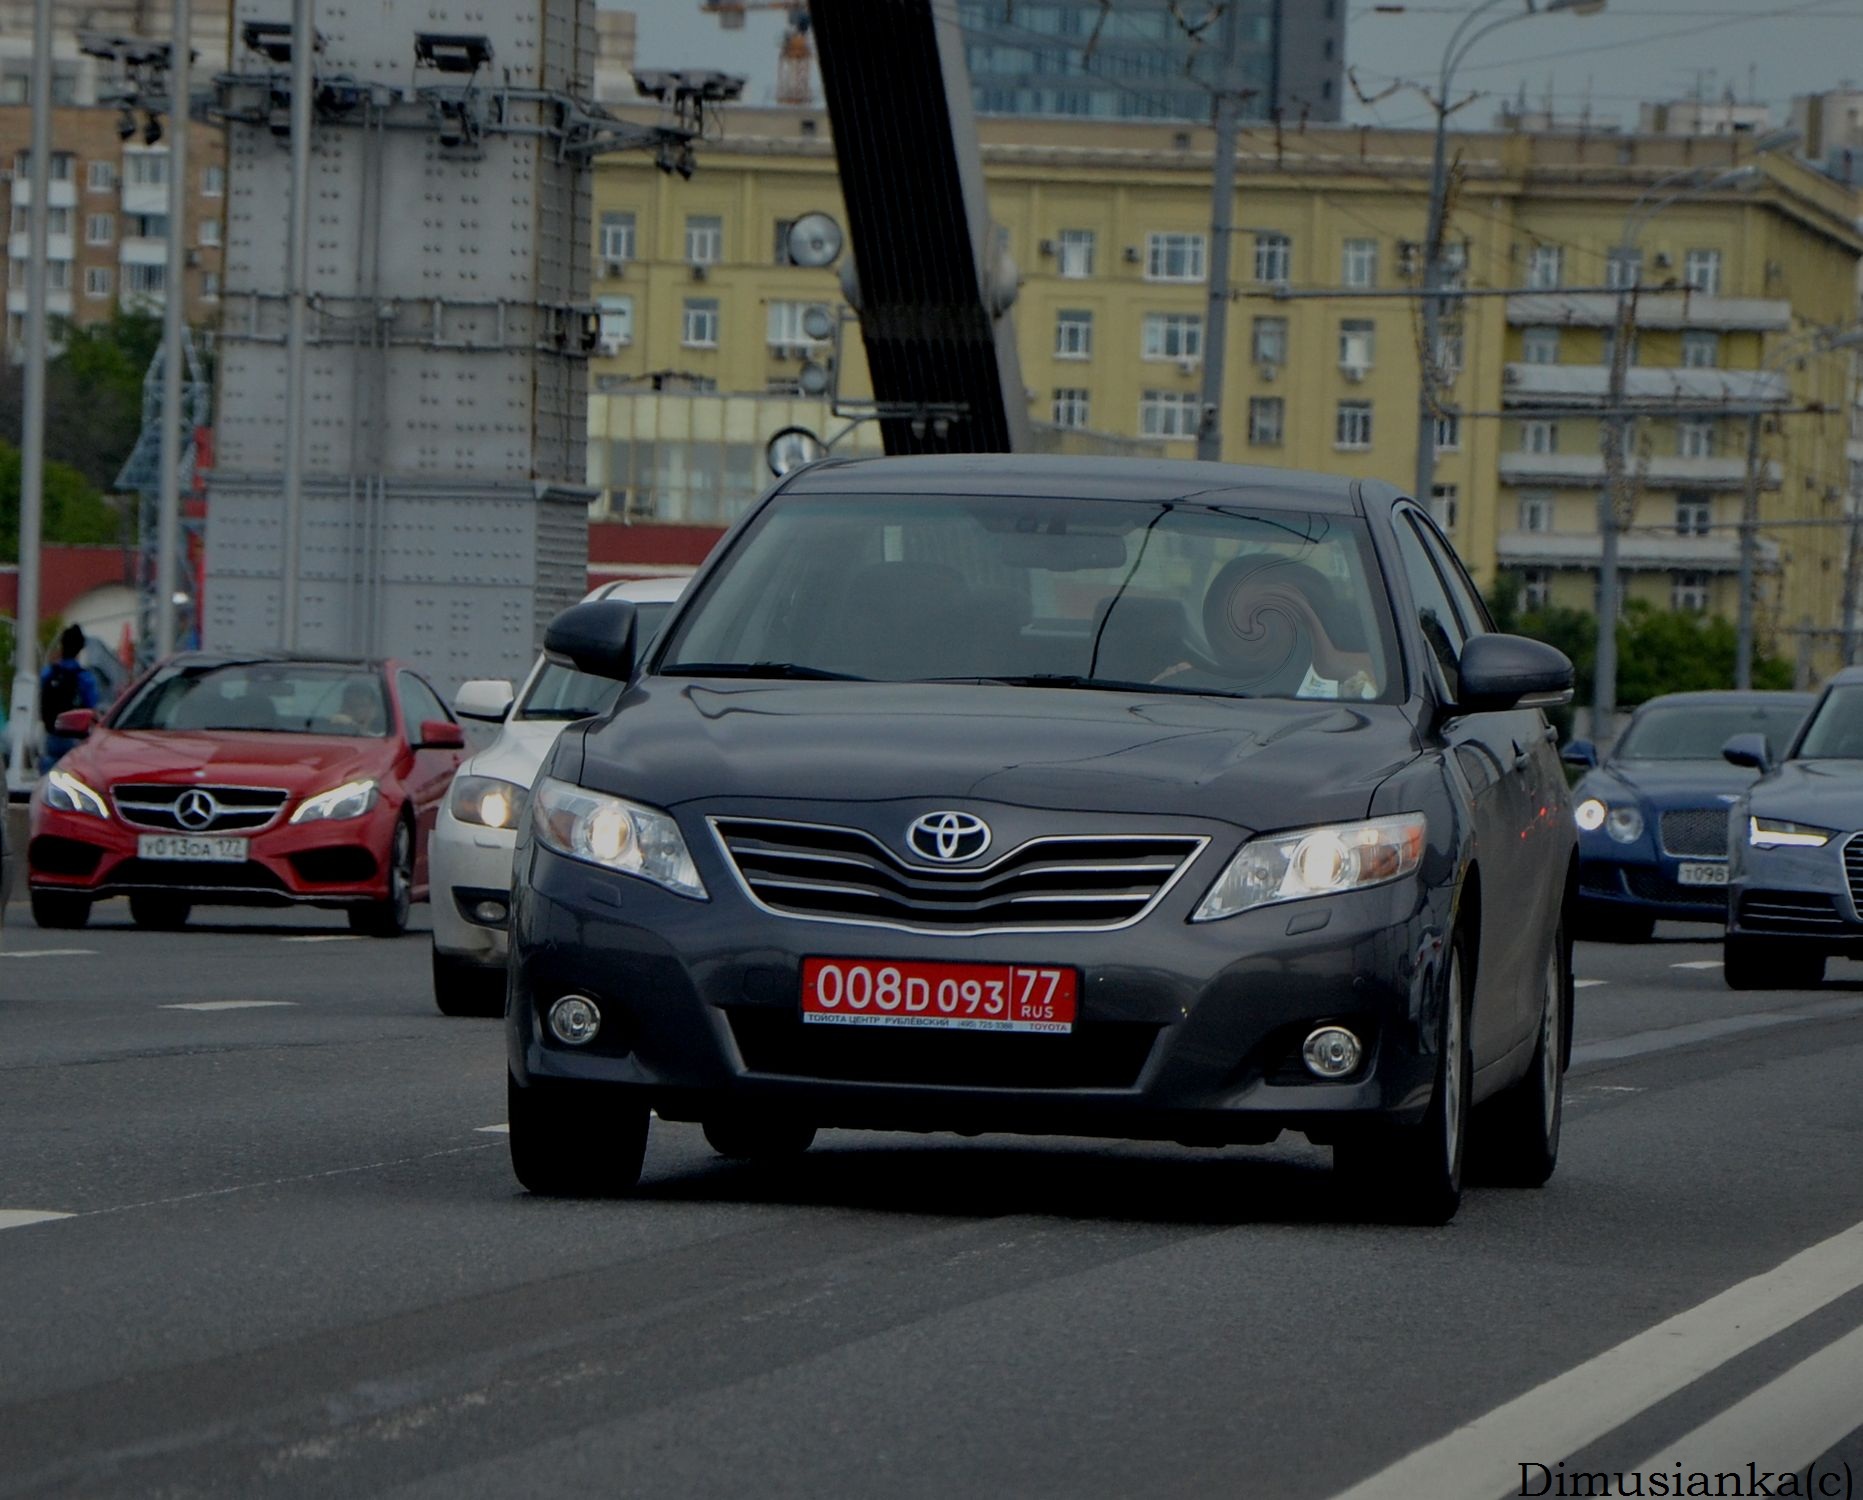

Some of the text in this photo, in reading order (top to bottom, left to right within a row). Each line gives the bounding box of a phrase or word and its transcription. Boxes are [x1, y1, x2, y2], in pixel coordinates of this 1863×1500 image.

[1017, 969, 1061, 1004] 77
[1021, 1005, 1054, 1019] RUS
[808, 1013, 848, 1023] ТОЙОТА
[849, 1015, 880, 1025] ЦЕНТР
[1029, 1022, 1068, 1032] TOYOTA
